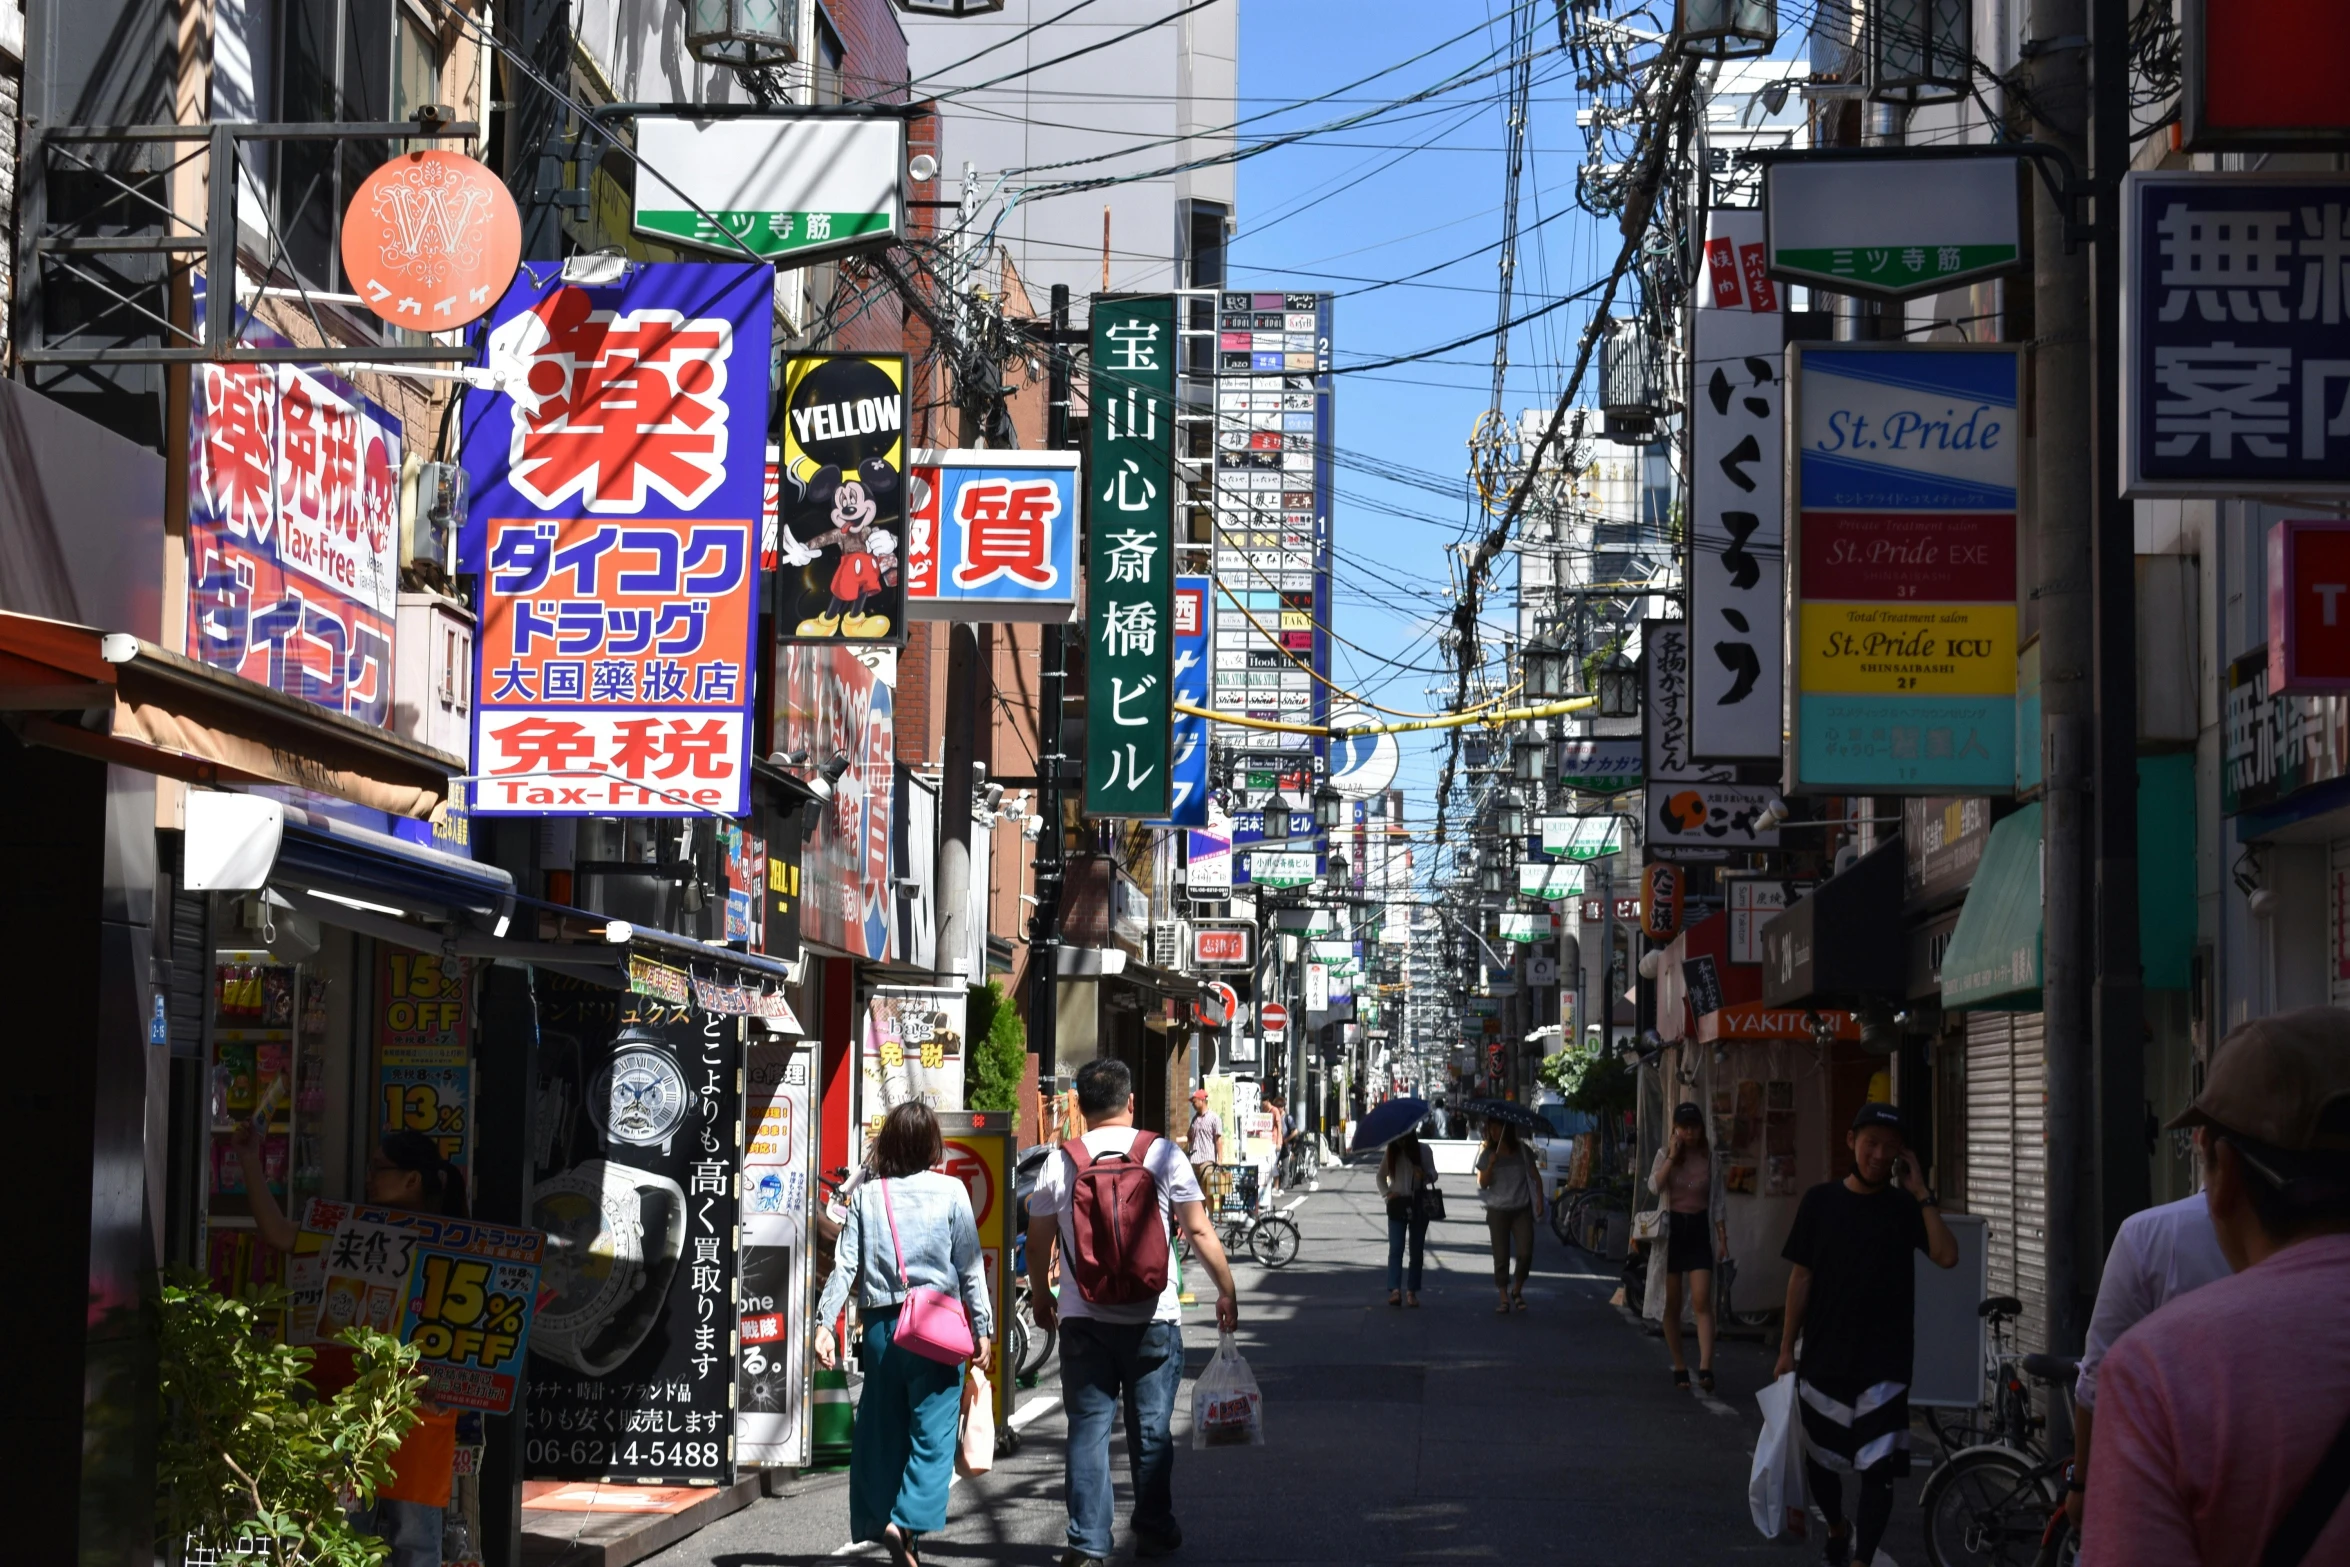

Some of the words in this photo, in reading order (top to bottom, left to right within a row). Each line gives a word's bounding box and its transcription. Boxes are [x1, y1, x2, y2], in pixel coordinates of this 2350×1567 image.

[693, 213, 832, 240] 三ツ寺筋
[1831, 246, 1961, 274] 三ツ寺筋
[366, 279, 492, 318] ワカイケ
[791, 394, 901, 444] YELLOW
[1817, 406, 2001, 452] St.Pride
[280, 376, 359, 543] 免税
[282, 511, 356, 588] Tax-Free
[957, 477, 1060, 591] 質
[1949, 545, 1989, 565] EXE
[491, 524, 748, 596] ダイコク
[1100, 319, 1160, 793] 宝山心斎橋ビル
[513, 602, 707, 656] ドラッグ
[1846, 610, 1879, 623] Total
[1879, 611, 1936, 624] Treatment
[1938, 612, 1969, 624] salon
[1249, 657, 1278, 668] Hook
[1822, 629, 1935, 658] St.Pride
[1946, 640, 1992, 658] ICU
[1860, 664, 1955, 674] SHINSAIBASHI
[1896, 677, 1917, 689] 2F
[1657, 631, 1687, 773] 名物かすうどん
[488, 716, 735, 780] 免税
[497, 781, 722, 806] Tax-Free
[1649, 866, 1675, 933] たこ焼
[388, 952, 463, 1000] 15%
[153, 1025, 165, 1038] 2-15
[387, 1000, 463, 1033] OFF
[889, 1018, 934, 1040] bag
[879, 1041, 944, 1069] 免税
[384, 1083, 466, 1133] 13%
[689, 1012, 730, 1380] どこよりも高く買取ります
[474, 1227, 541, 1251] ドラッグ
[421, 1255, 526, 1334] 15%
[410, 1322, 520, 1369] OFF
[526, 1438, 719, 1468] 06-6214-5488
